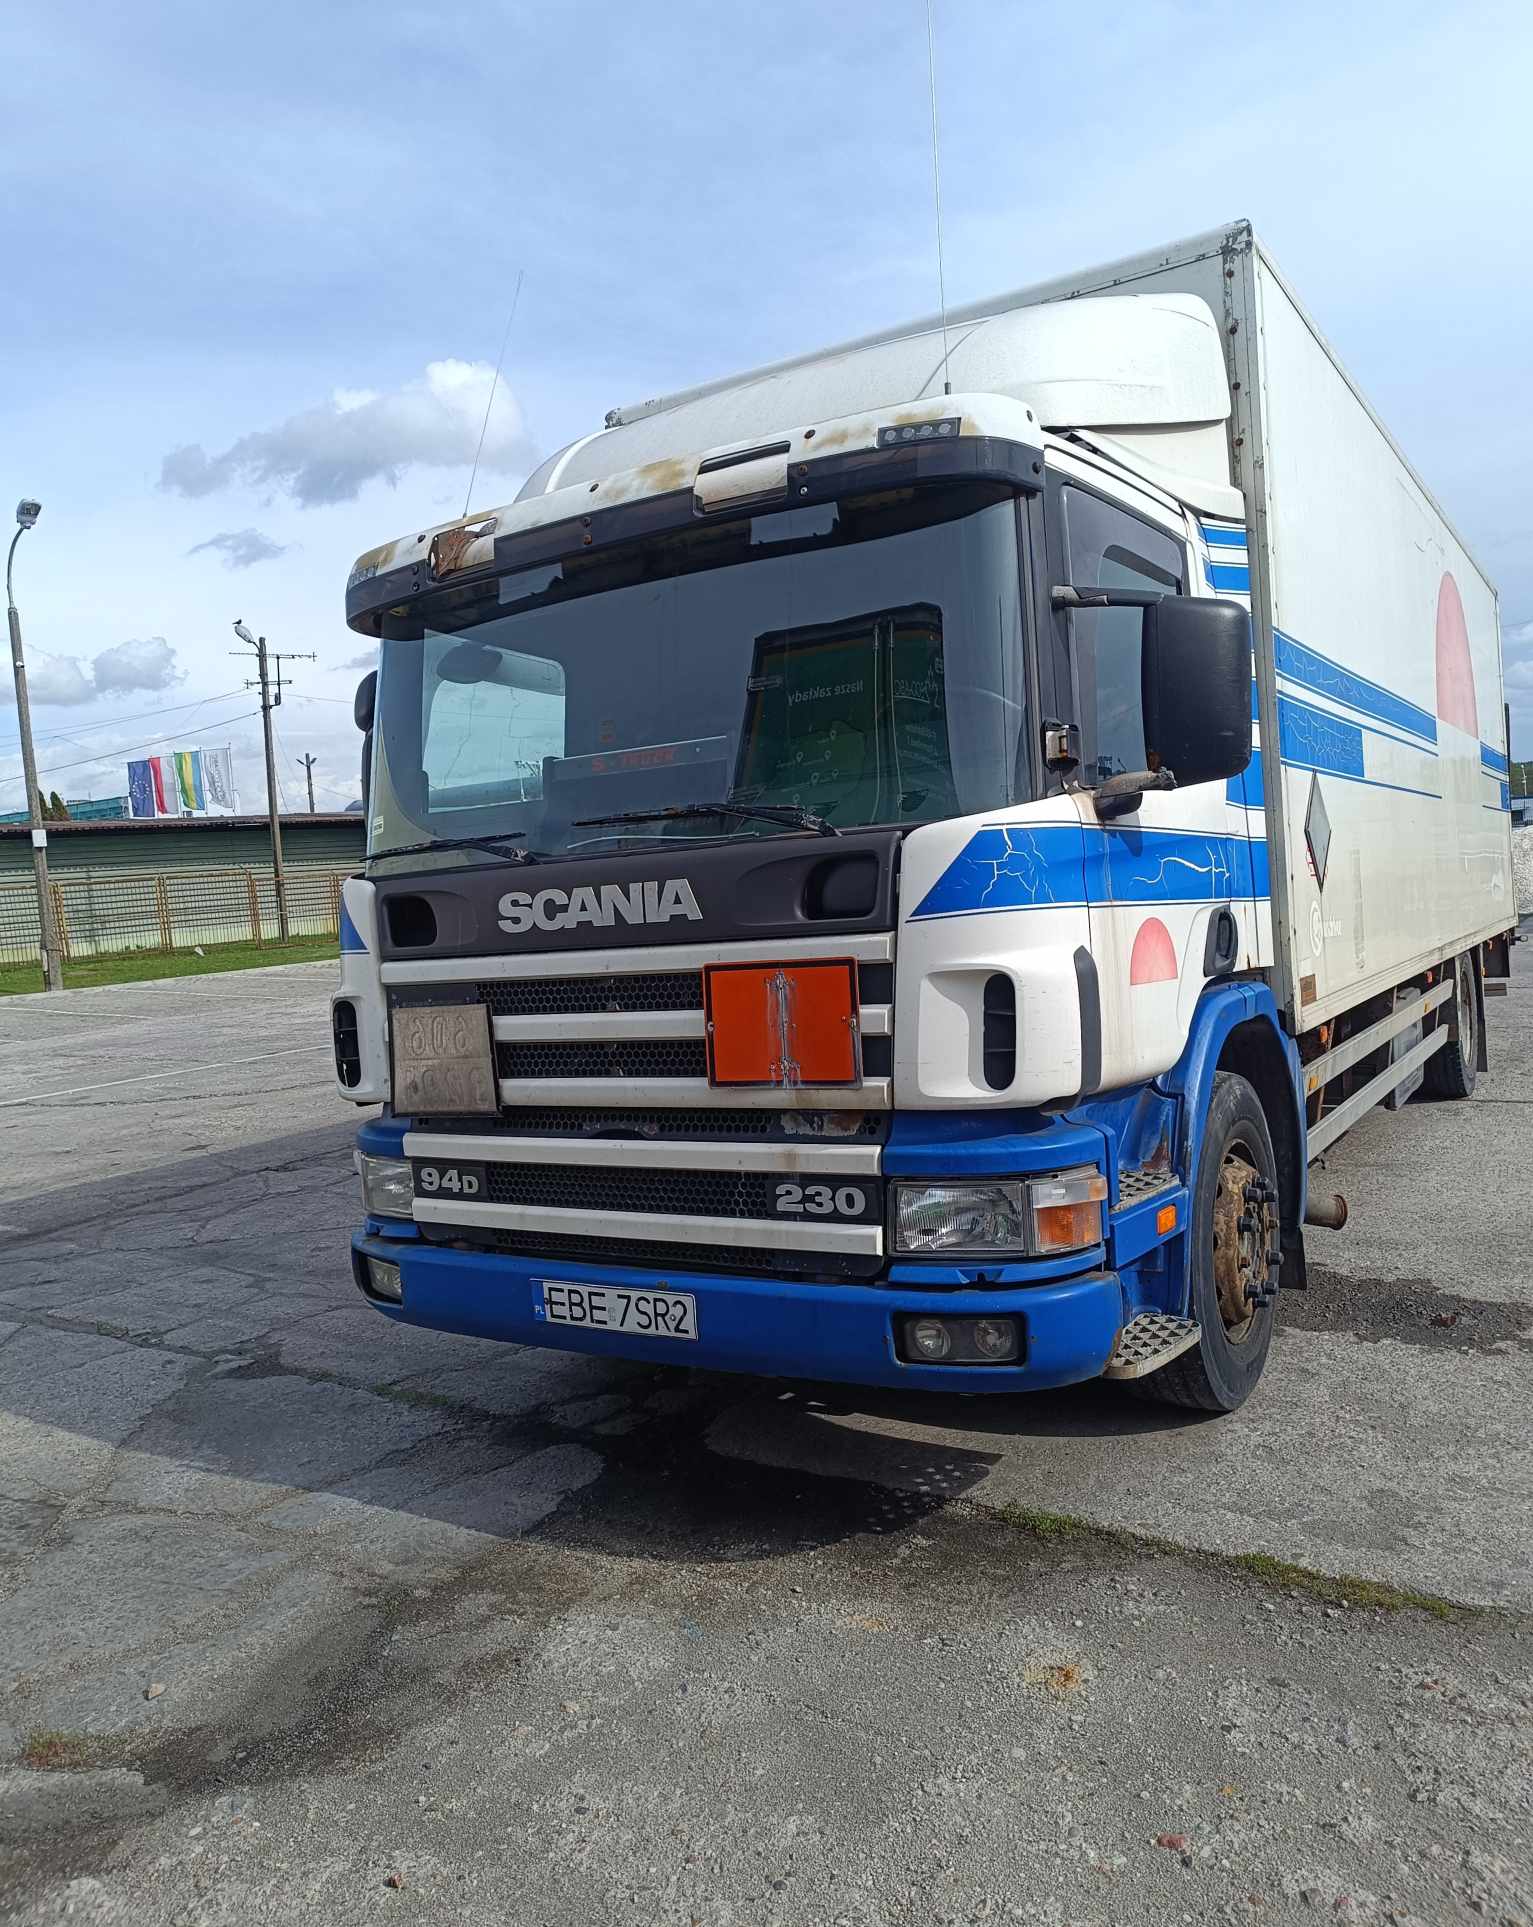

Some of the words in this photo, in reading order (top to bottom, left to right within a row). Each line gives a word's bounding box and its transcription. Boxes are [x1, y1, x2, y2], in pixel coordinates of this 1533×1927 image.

[498, 878, 703, 934] SCANIA
[420, 1167, 479, 1194] 94D
[775, 1184, 866, 1216] 230
[534, 1304, 545, 1315] PL
[547, 1286, 608, 1326] EBE
[617, 1293, 690, 1334] 7SR2
